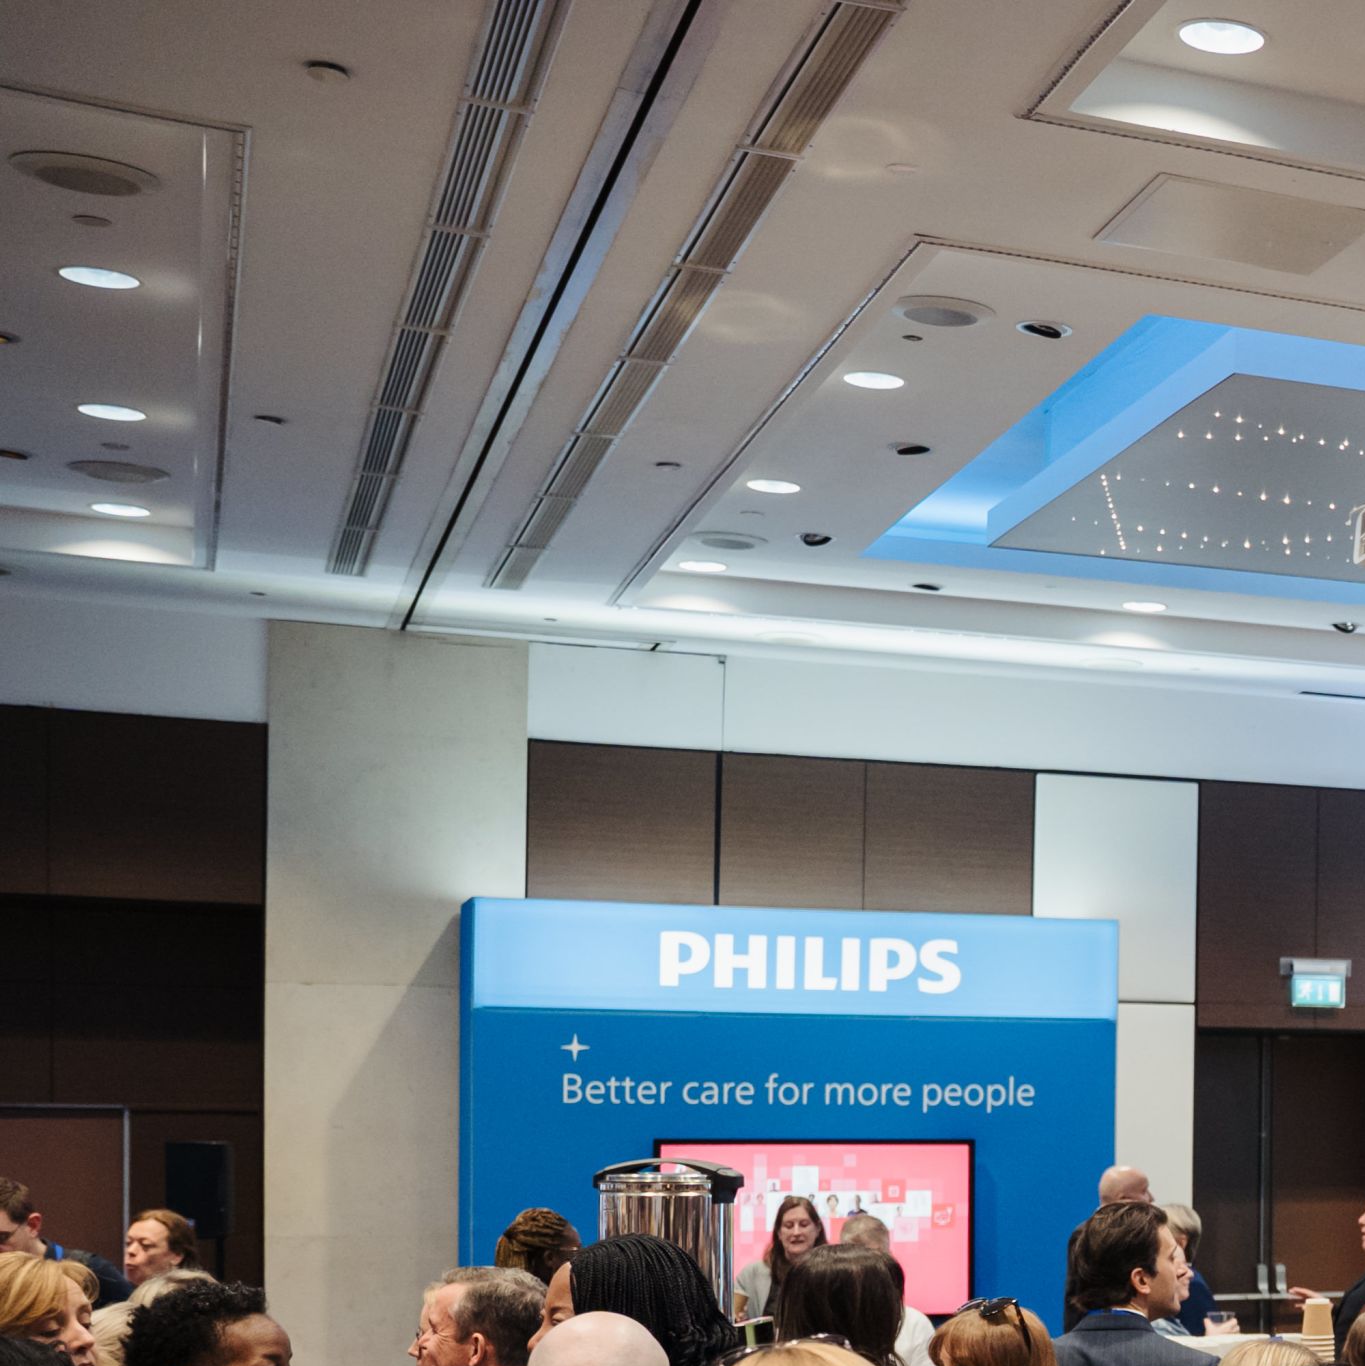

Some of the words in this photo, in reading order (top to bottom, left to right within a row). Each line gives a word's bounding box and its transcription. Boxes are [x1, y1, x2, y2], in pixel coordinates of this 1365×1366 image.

[659, 930, 963, 995] PHILIPS
[561, 1073, 672, 1105] Better
[682, 1080, 755, 1106] care
[765, 1073, 814, 1106] for
[824, 1080, 912, 1107] more
[922, 1075, 1035, 1114] people
